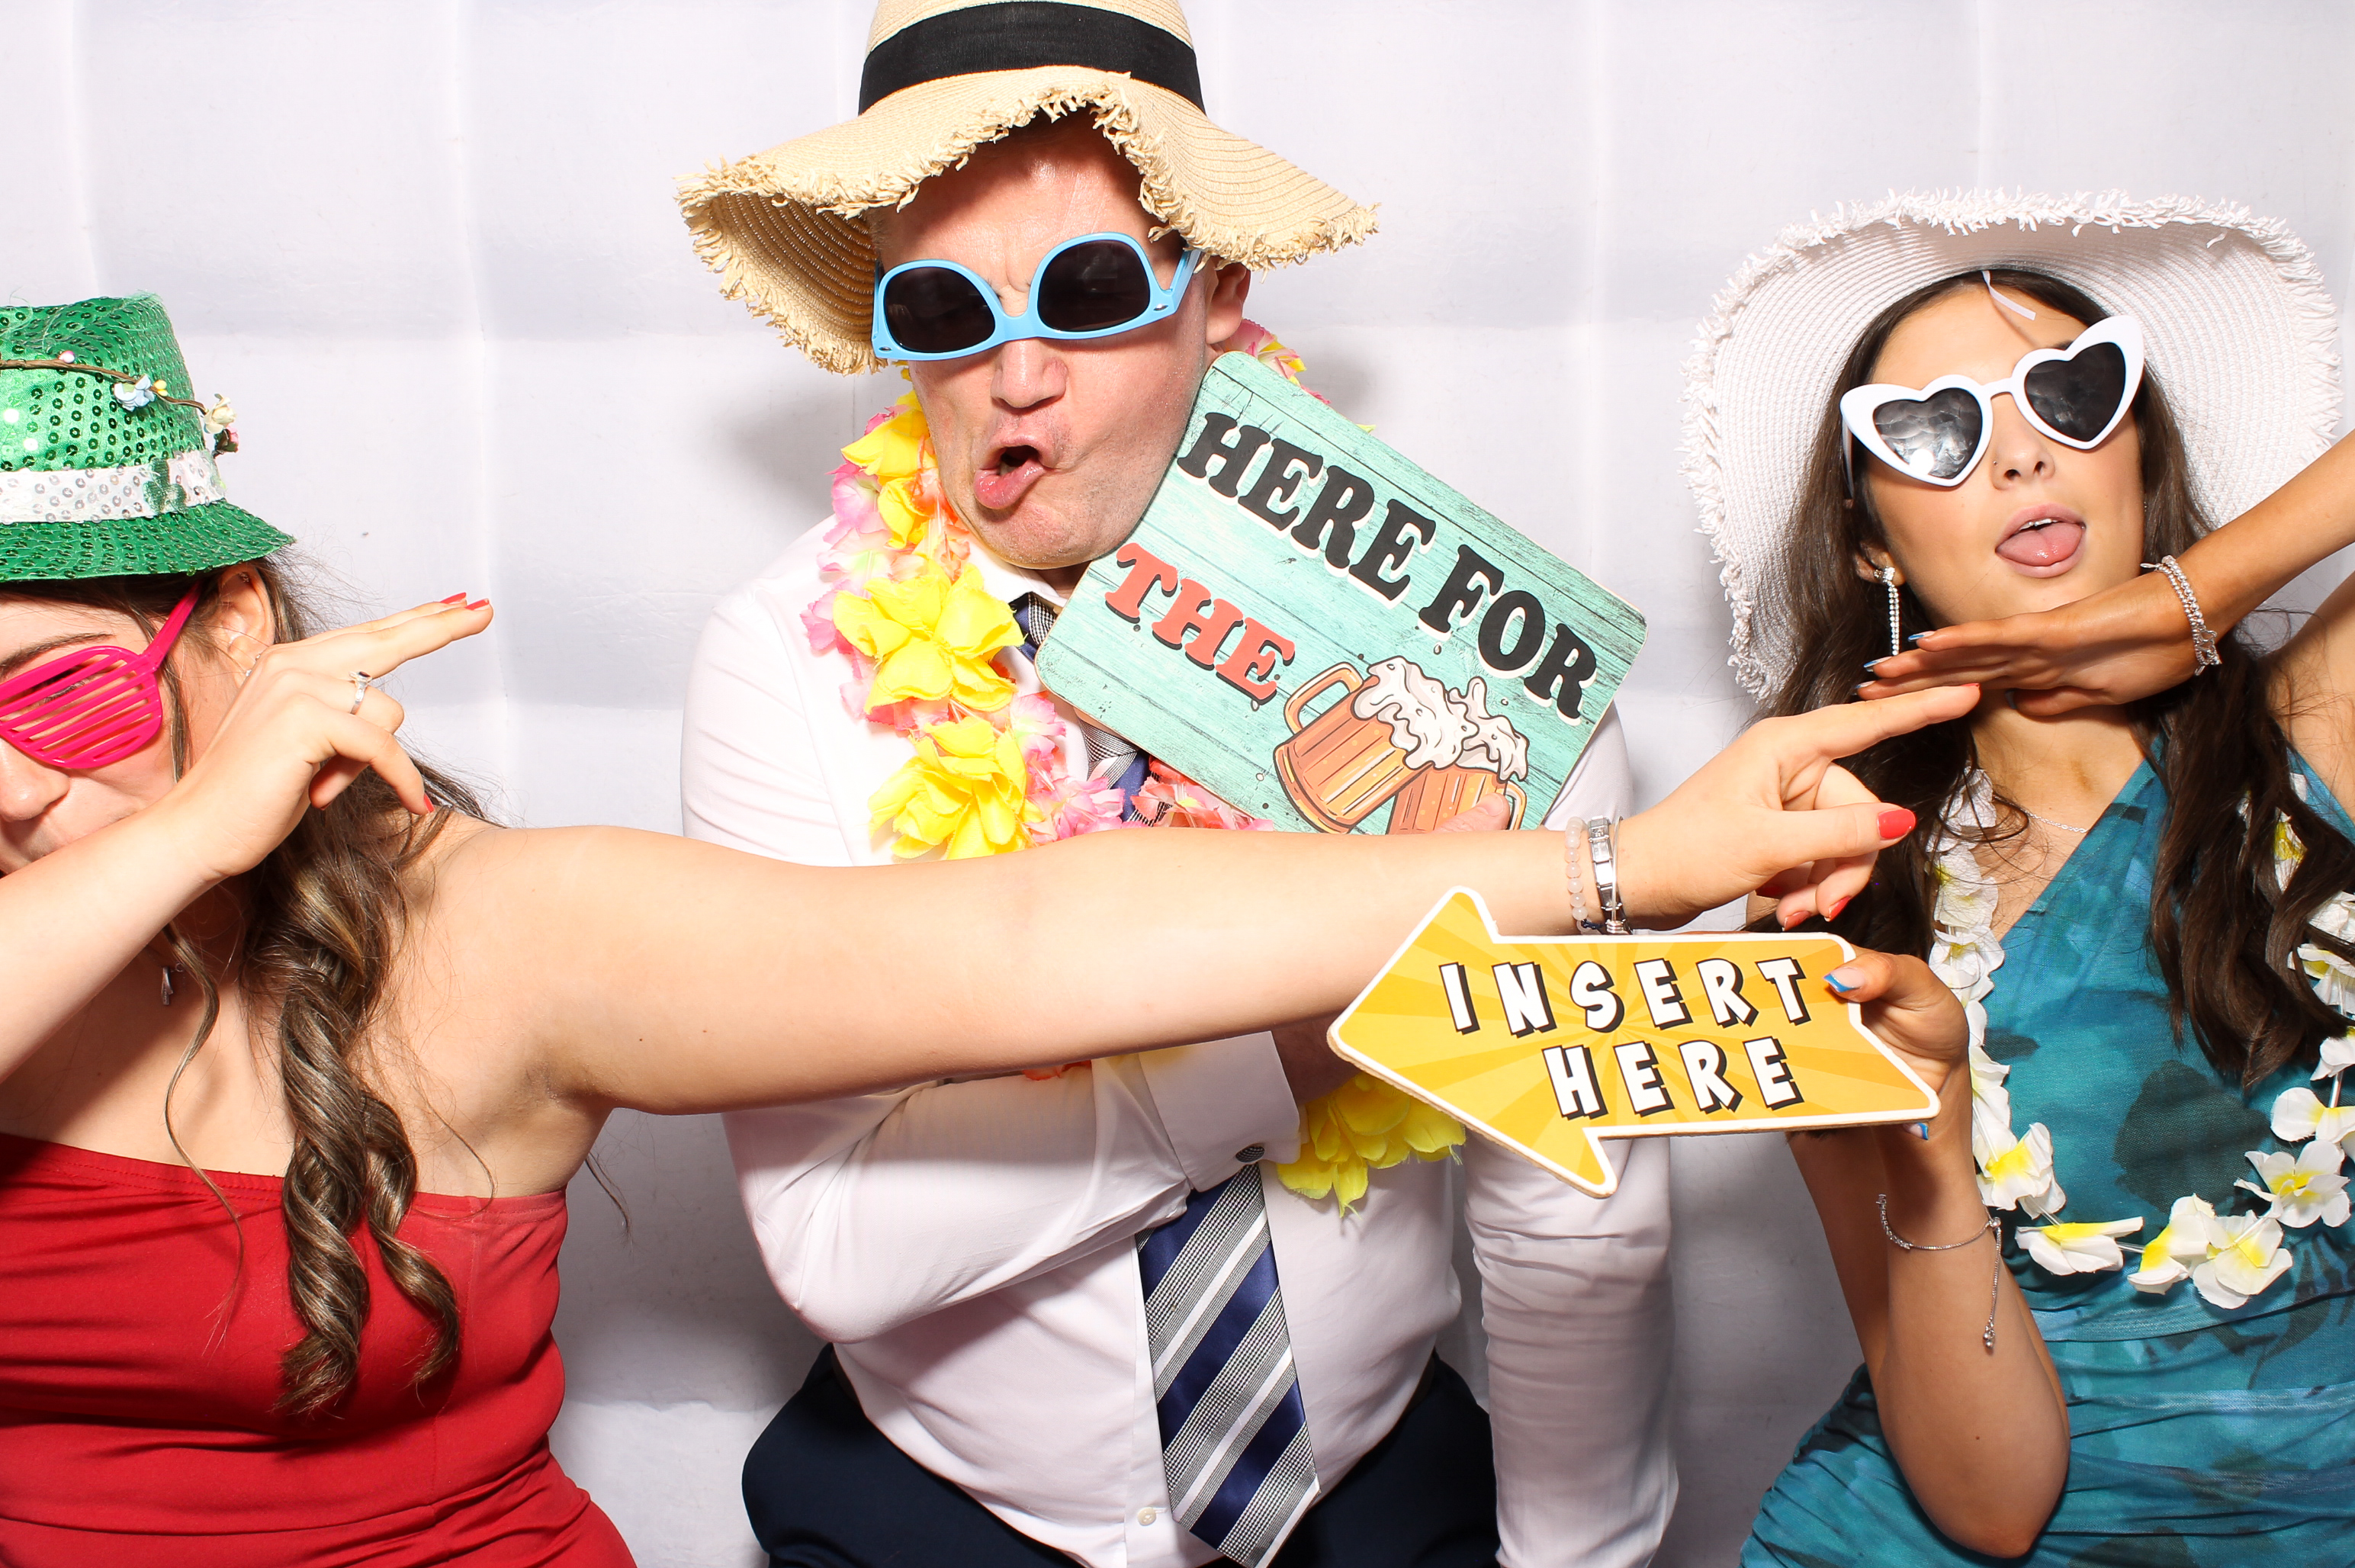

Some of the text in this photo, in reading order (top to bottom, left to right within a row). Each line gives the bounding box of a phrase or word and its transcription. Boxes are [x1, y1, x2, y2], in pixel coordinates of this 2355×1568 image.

[1105, 542, 1296, 705] THE
[1177, 412, 1599, 725] HERE FOR
[1438, 957, 1811, 1036] INSERT
[1541, 1036, 1804, 1120] HERE
